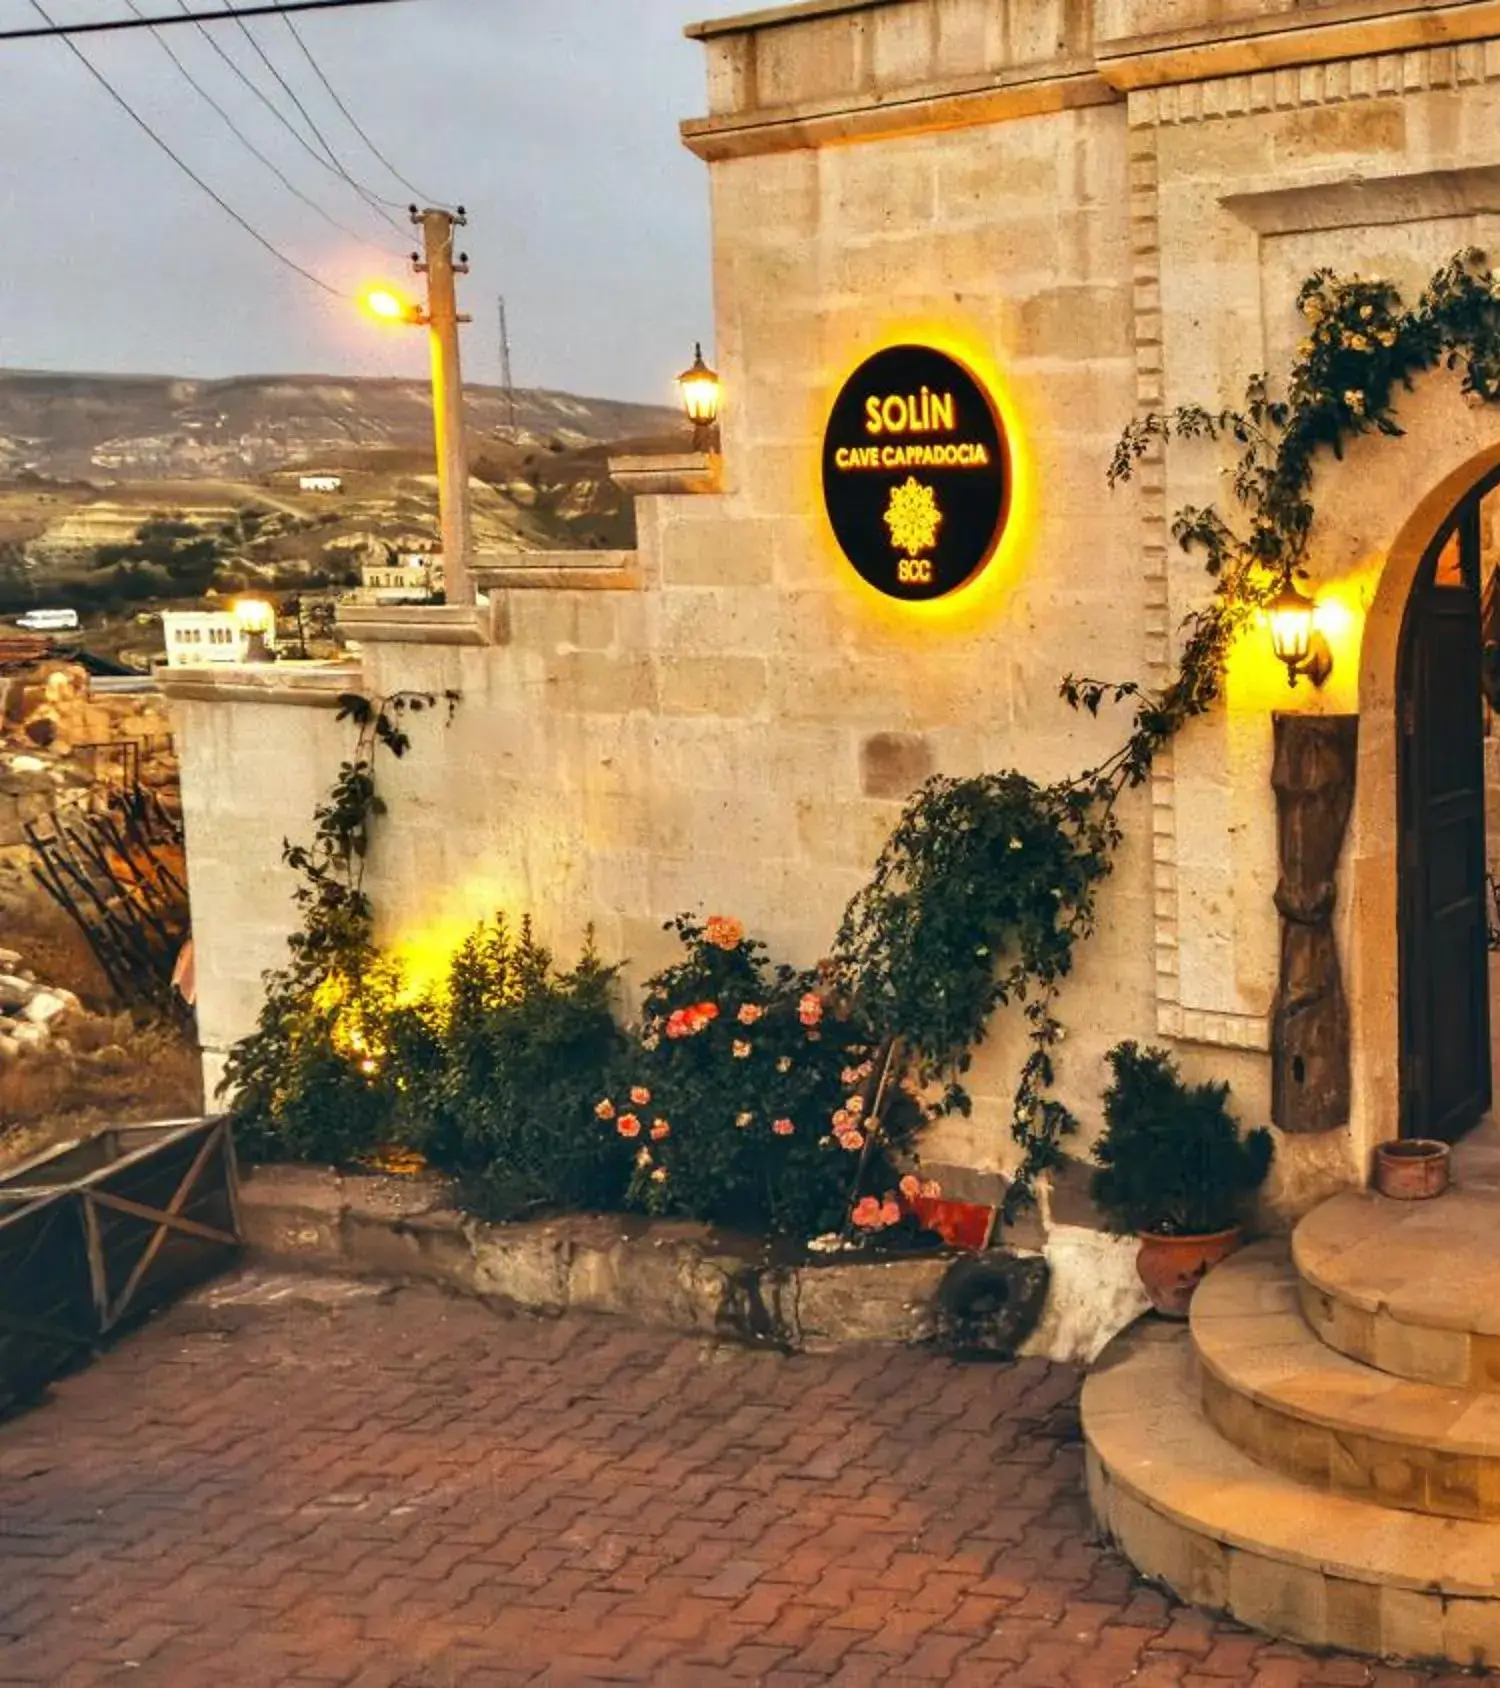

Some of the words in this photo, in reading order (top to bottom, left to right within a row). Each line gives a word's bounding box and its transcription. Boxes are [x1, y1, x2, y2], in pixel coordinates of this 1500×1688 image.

[865, 385, 955, 433] SOLİN
[835, 446, 879, 468] CAVE
[881, 443, 988, 467] CAPPADOCIA
